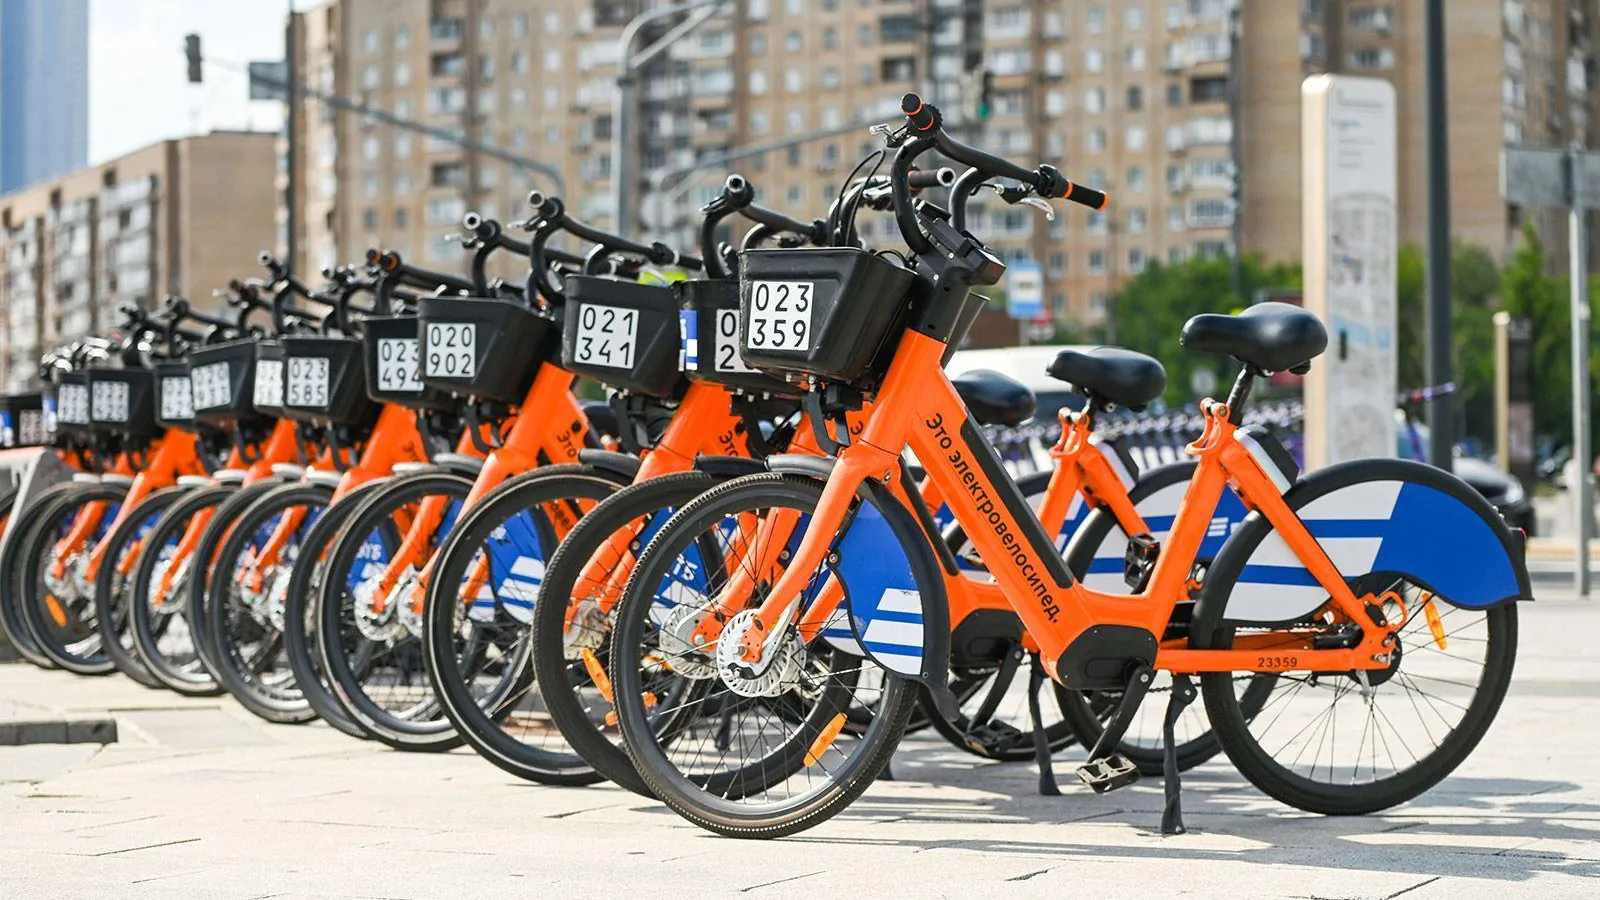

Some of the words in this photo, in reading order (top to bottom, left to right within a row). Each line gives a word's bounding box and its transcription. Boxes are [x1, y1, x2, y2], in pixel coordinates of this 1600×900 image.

[755, 283, 811, 312] 023
[583, 307, 633, 336] 021
[431, 326, 473, 348] 020
[752, 319, 807, 347] 359
[382, 341, 419, 363] 023
[580, 337, 631, 366] 341
[292, 360, 326, 379] 023
[430, 353, 472, 375] 902
[382, 367, 422, 387] 494
[291, 385, 325, 404] 585
[557, 430, 577, 458] Это
[926, 413, 953, 450] Это
[948, 450, 1062, 624] электровелосипед.
[1258, 657, 1297, 667] 23359
